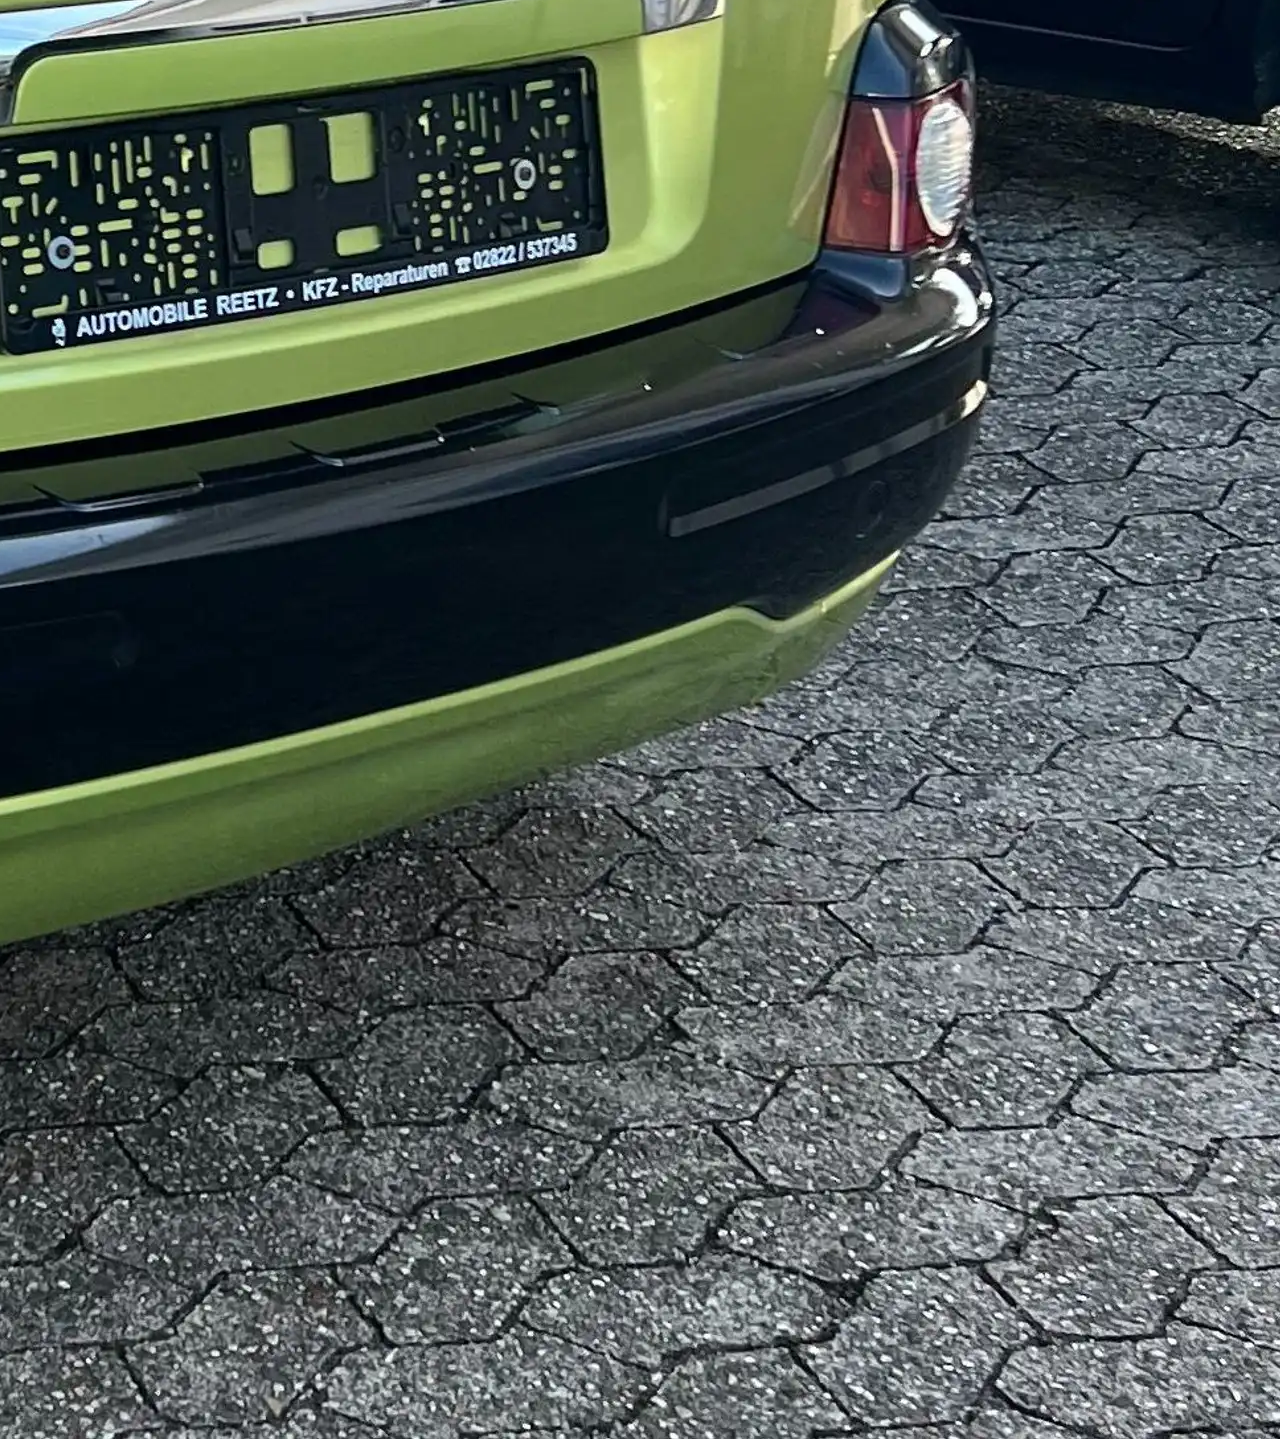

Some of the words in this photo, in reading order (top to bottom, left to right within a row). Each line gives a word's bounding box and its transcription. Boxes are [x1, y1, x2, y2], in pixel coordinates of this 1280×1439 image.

[76, 298, 209, 337] AUTOMOBILE
[215, 287, 280, 316] REETZ
[302, 276, 340, 301] KFZ
[351, 262, 448, 293] Reparaturen
[472, 244, 517, 271] 02822
[526, 232, 578, 260] 537345
